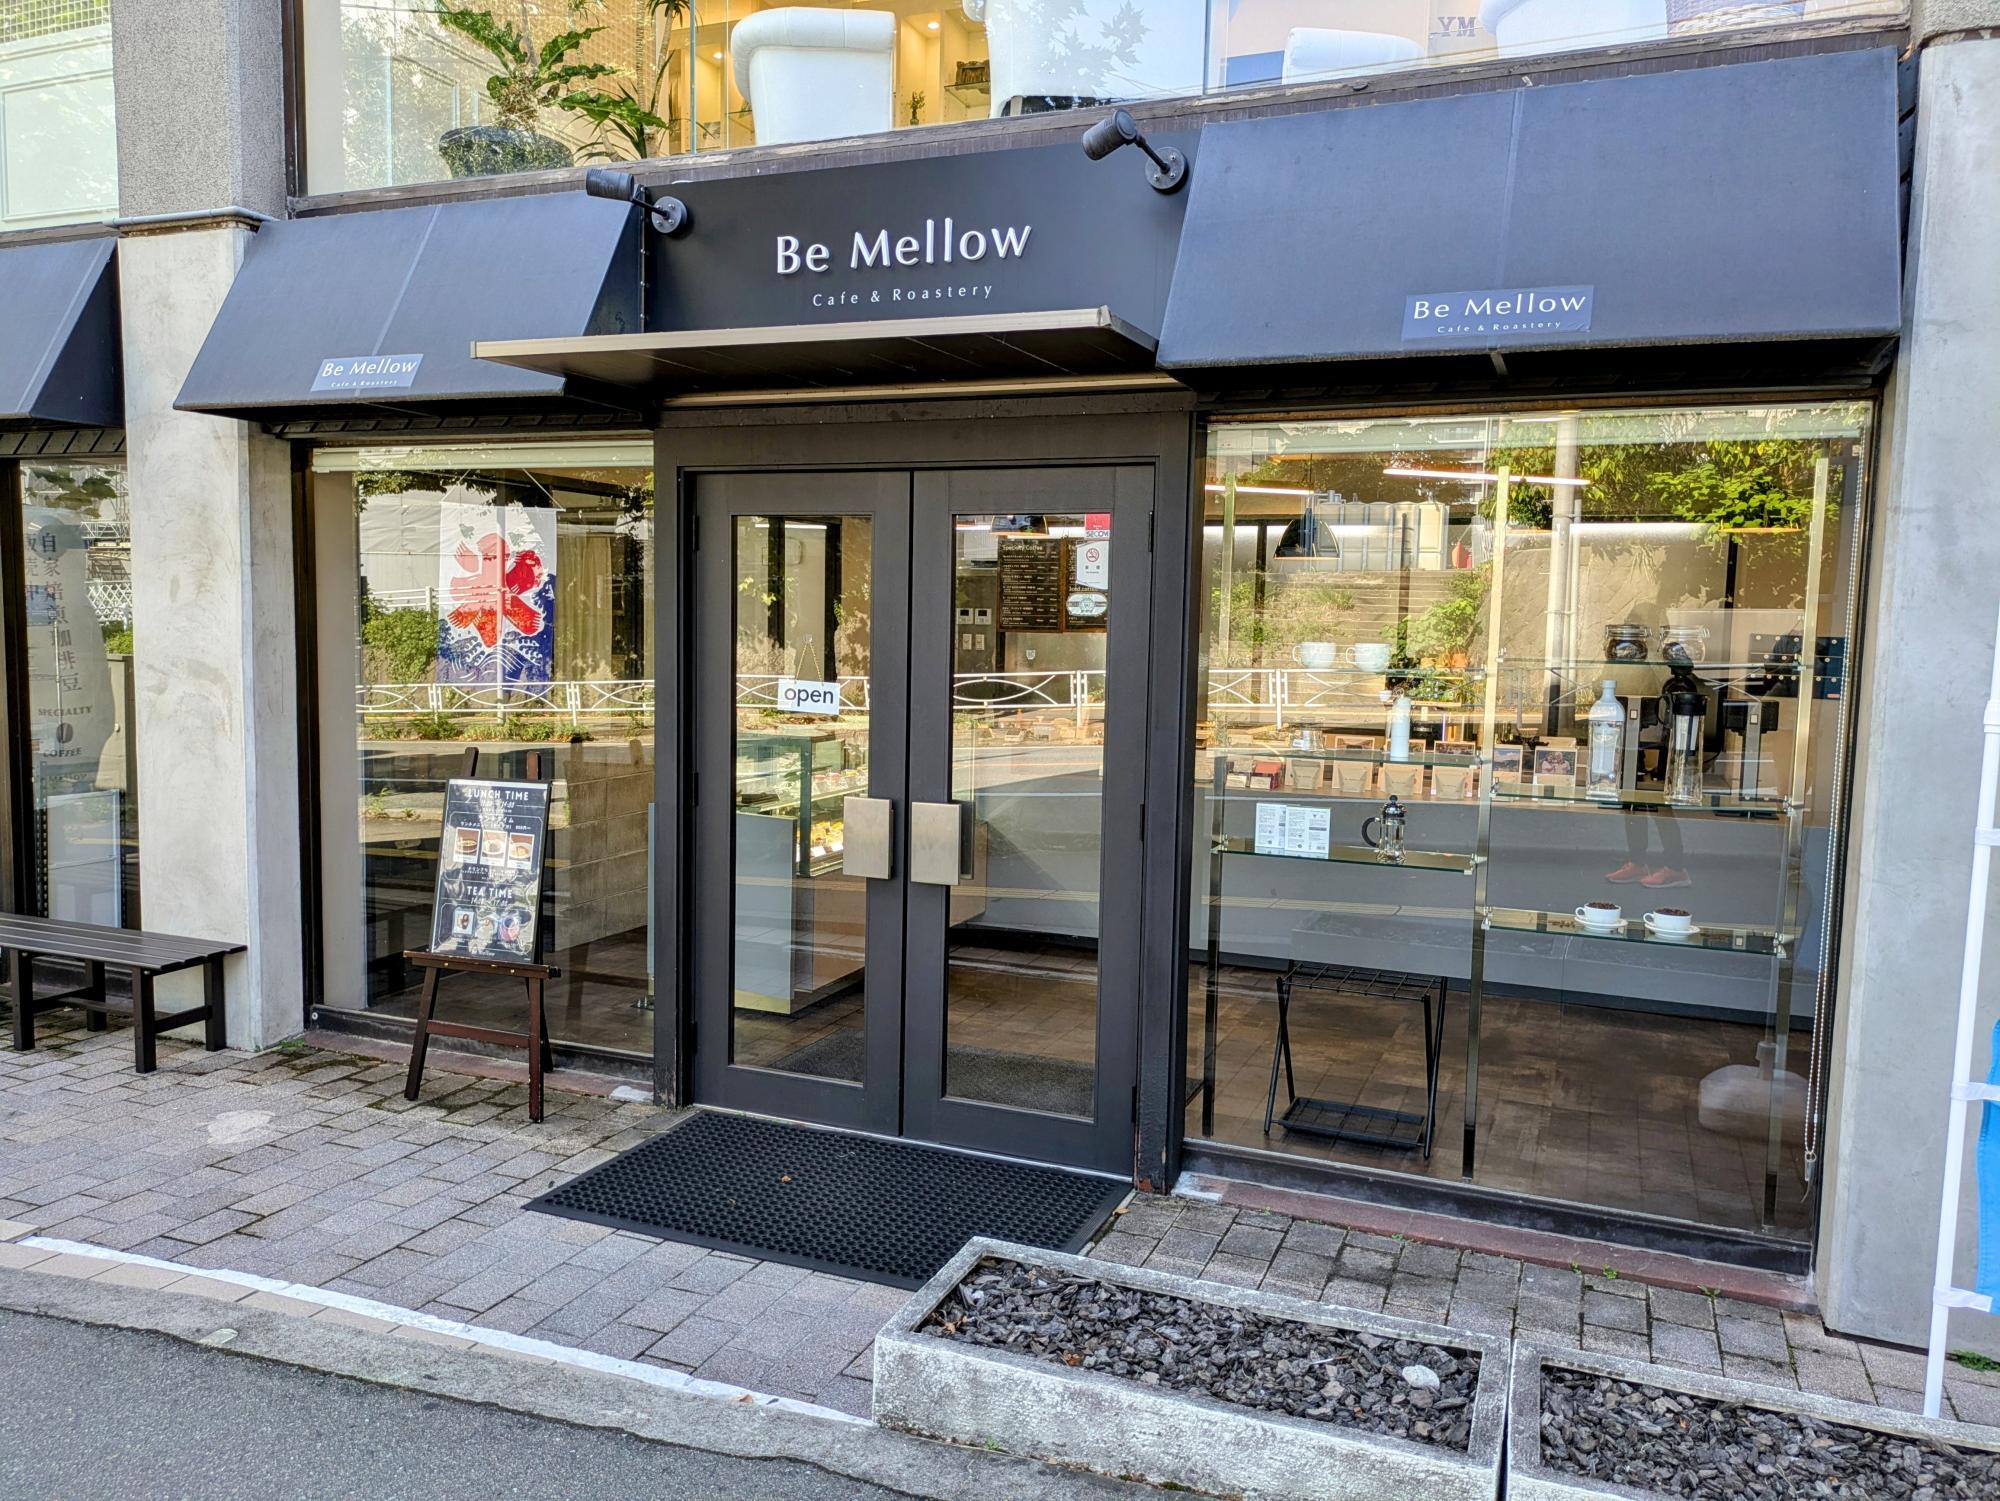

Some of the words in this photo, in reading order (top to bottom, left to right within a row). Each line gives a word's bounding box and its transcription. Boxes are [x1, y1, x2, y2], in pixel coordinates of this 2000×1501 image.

[777, 235, 830, 275] Be
[850, 217, 1032, 269] Mellow
[812, 290, 859, 307] Cafe
[870, 291, 881, 302] &
[892, 284, 993, 302] Roastery
[1413, 301, 1450, 320] Be
[1464, 292, 1586, 316] Mellow
[1437, 324, 1470, 333] Cafe
[1493, 321, 1561, 332] Roastery
[322, 362, 344, 377] Be
[349, 358, 418, 375] Mellow
[784, 687, 834, 707] open
[38, 704, 93, 717] SPECIALTY
[43, 747, 82, 758] COFFEE
[467, 788, 501, 799] LUNCH
[505, 790, 529, 801] TIME
[466, 885, 486, 897] TEA
[488, 887, 513, 899] TIME
